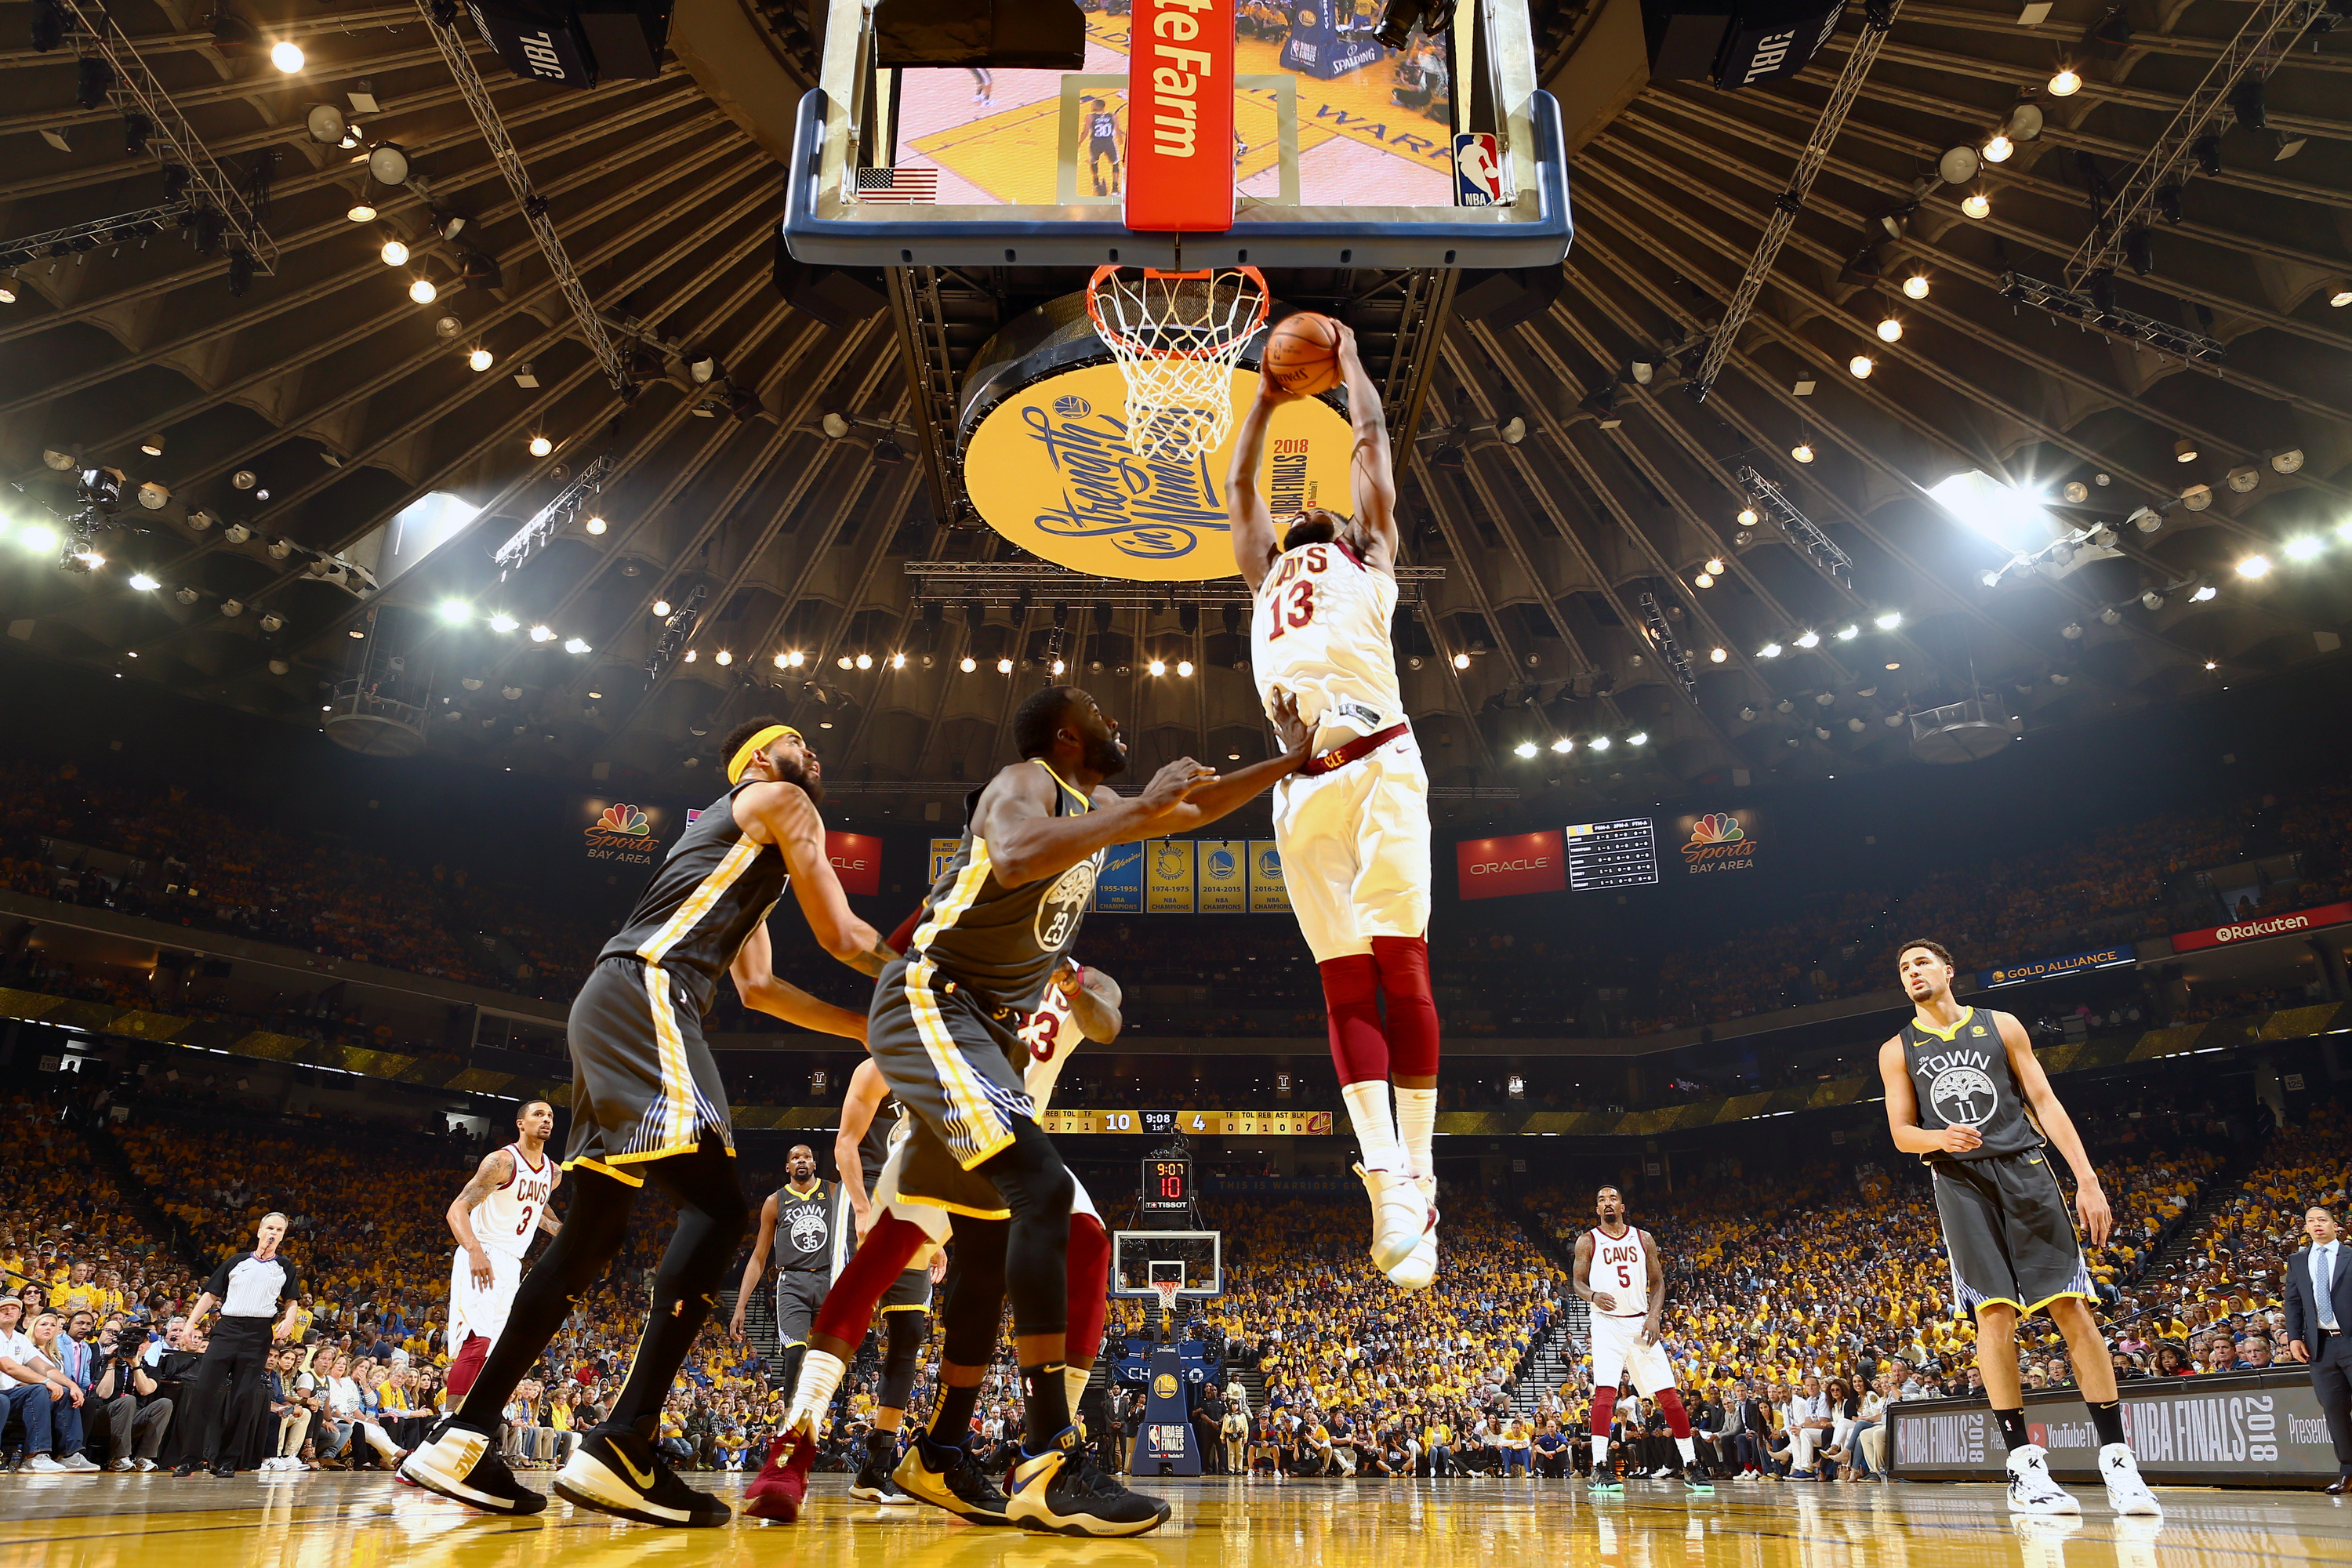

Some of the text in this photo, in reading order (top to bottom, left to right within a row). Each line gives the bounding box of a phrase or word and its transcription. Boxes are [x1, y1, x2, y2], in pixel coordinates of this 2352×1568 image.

[519, 31, 565, 79] JBL
[1333, 47, 1375, 74] SPALDING
[1743, 35, 1791, 84] JBL
[1153, 0, 1214, 158] teFarm
[1465, 193, 1486, 206] NBA
[1273, 439, 1308, 453] 2018
[1022, 406, 1150, 537] Strength
[1270, 455, 1308, 514] NBA FINALS
[1269, 579, 1314, 642] 13
[1323, 750, 1345, 768] CLE
[584, 826, 659, 851] Sports
[587, 849, 651, 865] BAY AREA
[1681, 839, 1757, 864] Sports
[829, 856, 866, 870] CLE
[1156, 868, 1185, 880] BASKETBALL
[1469, 857, 1548, 876] ORACLE
[1689, 858, 1754, 874] BAY AREA
[1208, 871, 1236, 880] WARRIORS
[1259, 871, 1283, 880] WARRIOR
[1043, 912, 1069, 944] 23
[2231, 916, 2309, 939] Rakuten
[2007, 950, 2118, 978] GOLD ALLIANCE
[41, 1062, 56, 1071] 118
[1916, 1049, 1991, 1080] TOWN
[1918, 1055, 1929, 1065] The
[1105, 1113, 1131, 1131] 10
[1146, 1113, 1171, 1123] 9:08
[1192, 1114, 1206, 1131] 4
[1955, 1100, 1981, 1123] 11
[1157, 1163, 1184, 1176] 9:07
[517, 1178, 548, 1206] CAVS
[1161, 1177, 1180, 1198] 10
[1219, 1181, 1366, 1190] THIS IS WARRIORS GRO
[516, 1206, 533, 1236] 3
[784, 1203, 826, 1225] TOWN
[802, 1236, 818, 1250] 35
[1602, 1246, 1638, 1265] CAVS
[1617, 1265, 1631, 1288] 5
[1161, 1425, 1175, 1439] NBA
[1907, 1414, 1968, 1464] NBA FINALS
[1968, 1414, 1985, 1463] 2018
[2132, 1396, 2246, 1462] NBA FINALS
[2245, 1395, 2278, 1461] 2018
[1161, 1438, 1185, 1451] FINALS
[454, 1438, 485, 1477] NIKE
